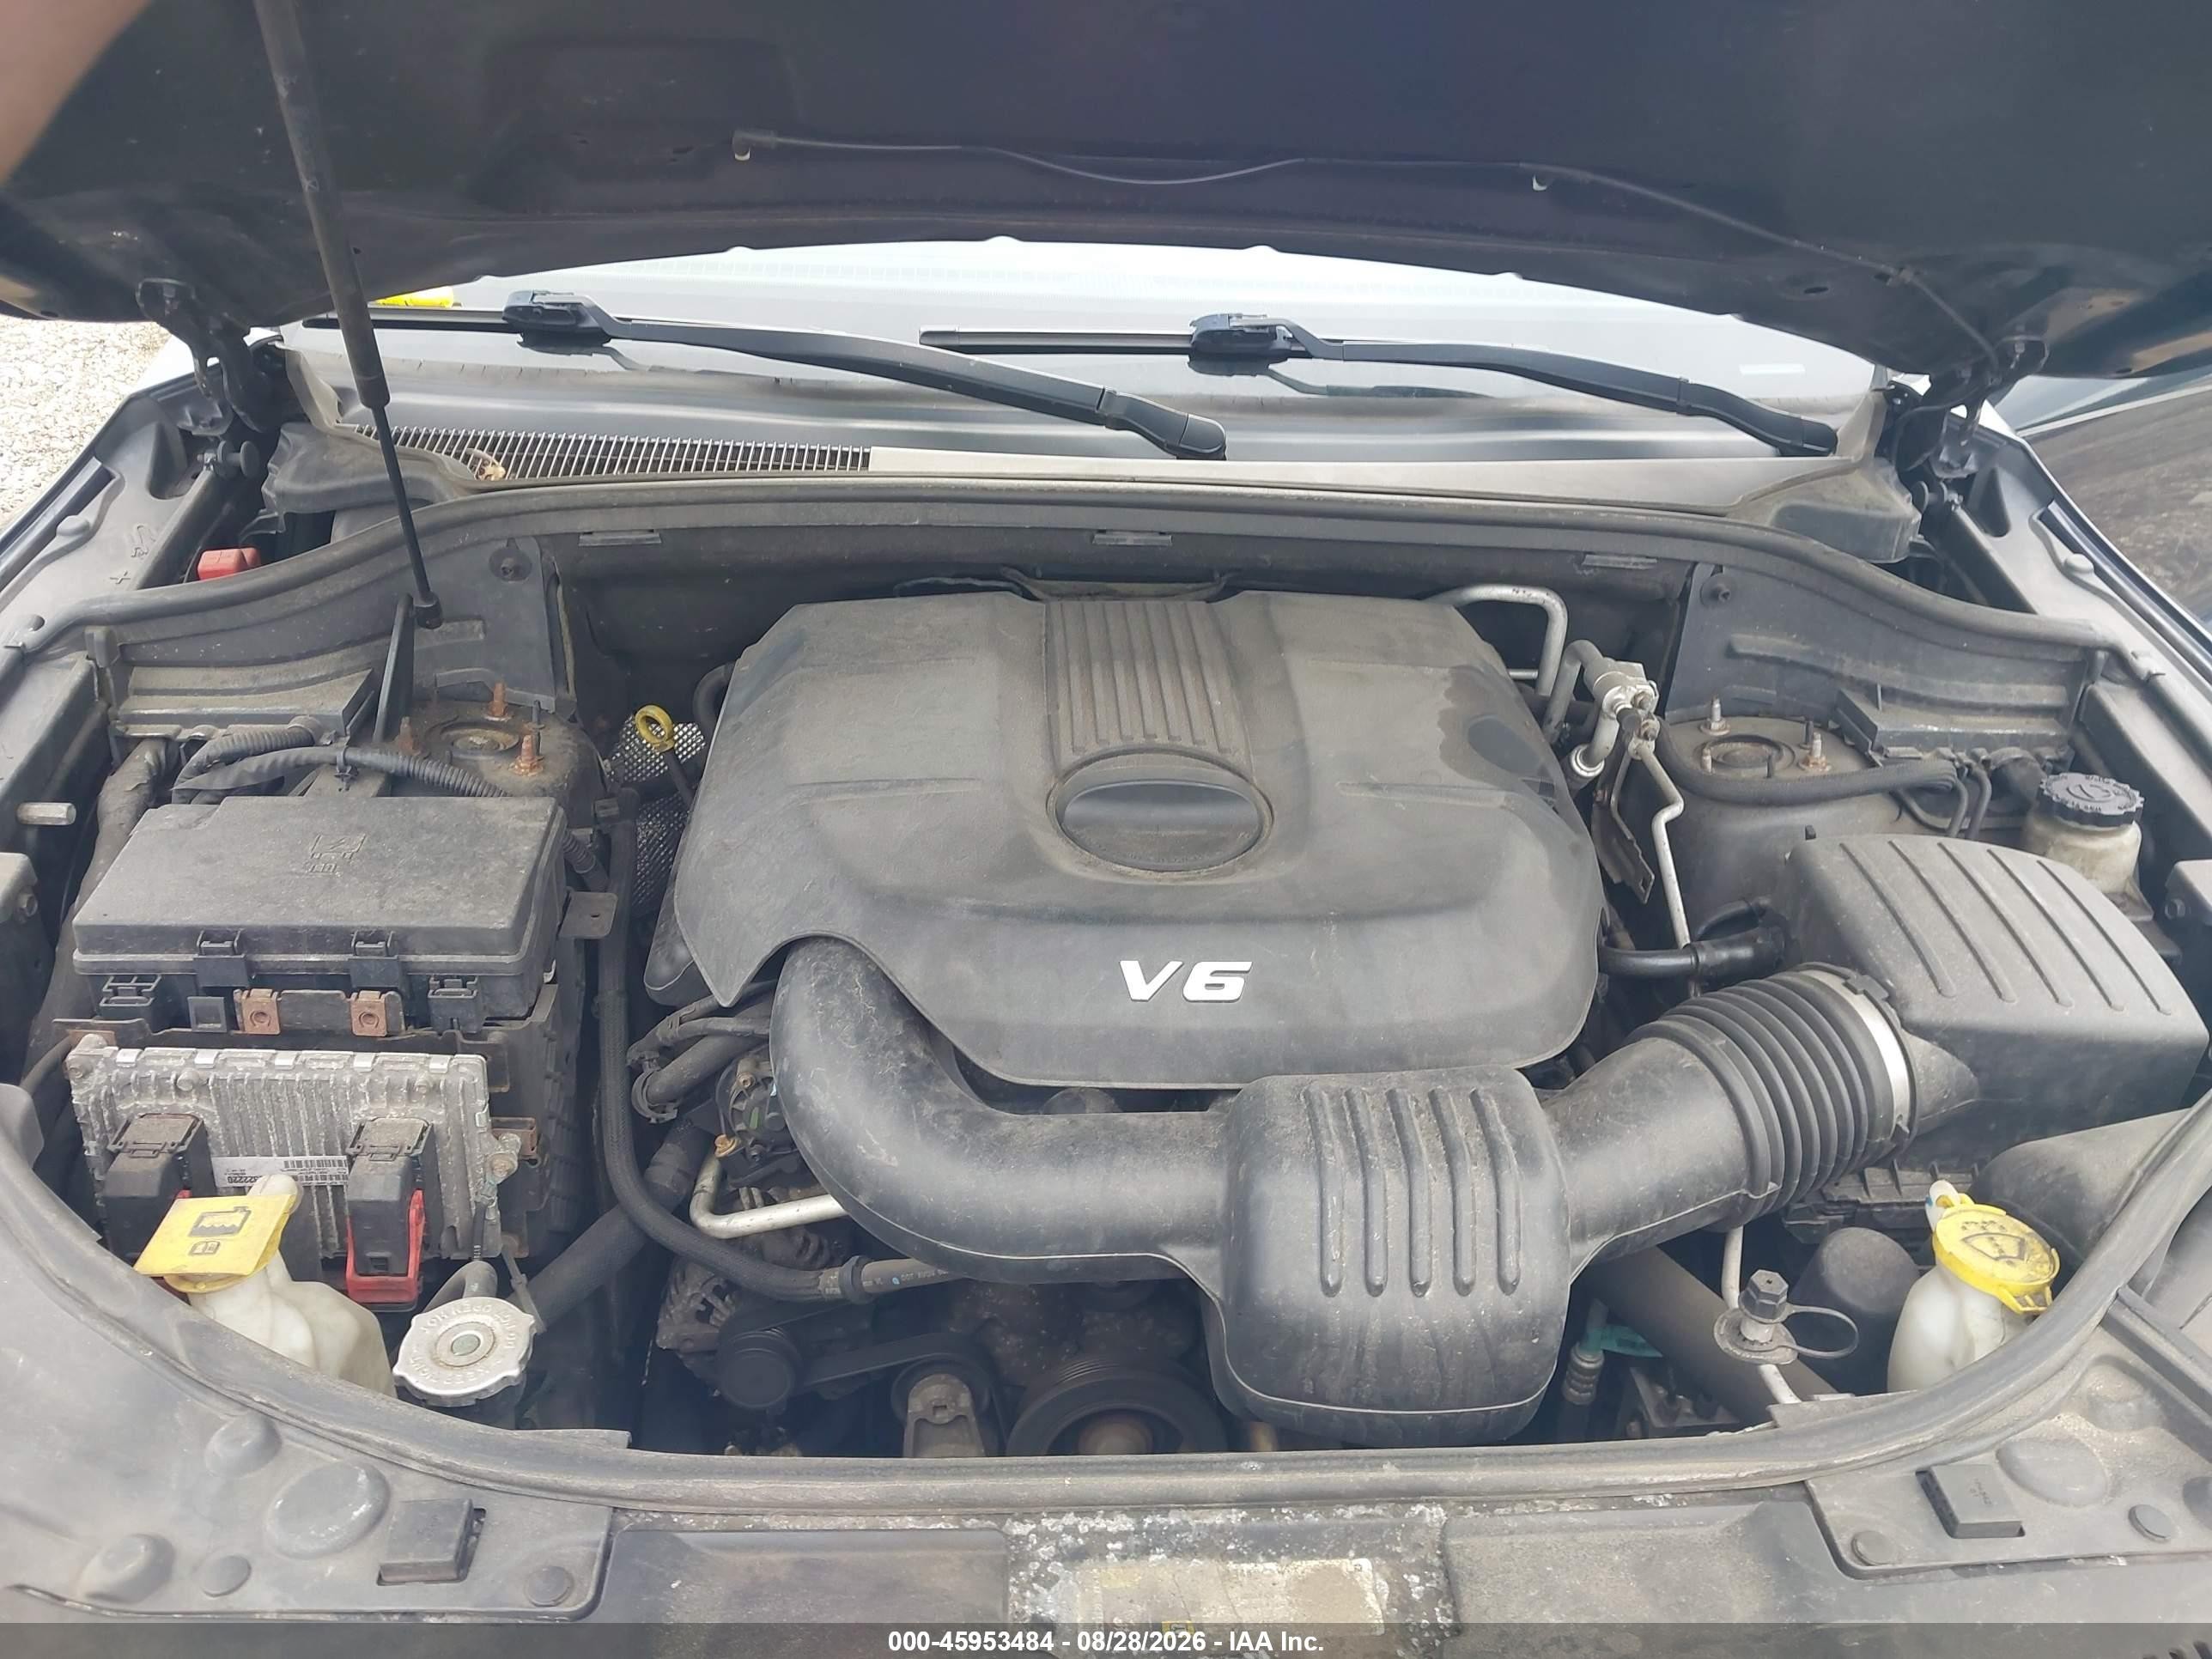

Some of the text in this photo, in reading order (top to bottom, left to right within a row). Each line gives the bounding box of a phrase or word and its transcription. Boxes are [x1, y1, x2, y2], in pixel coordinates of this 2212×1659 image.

[1120, 960, 1253, 1003] V6
[452, 1301, 493, 1316] OPEN
[420, 1310, 449, 1333] HOT
